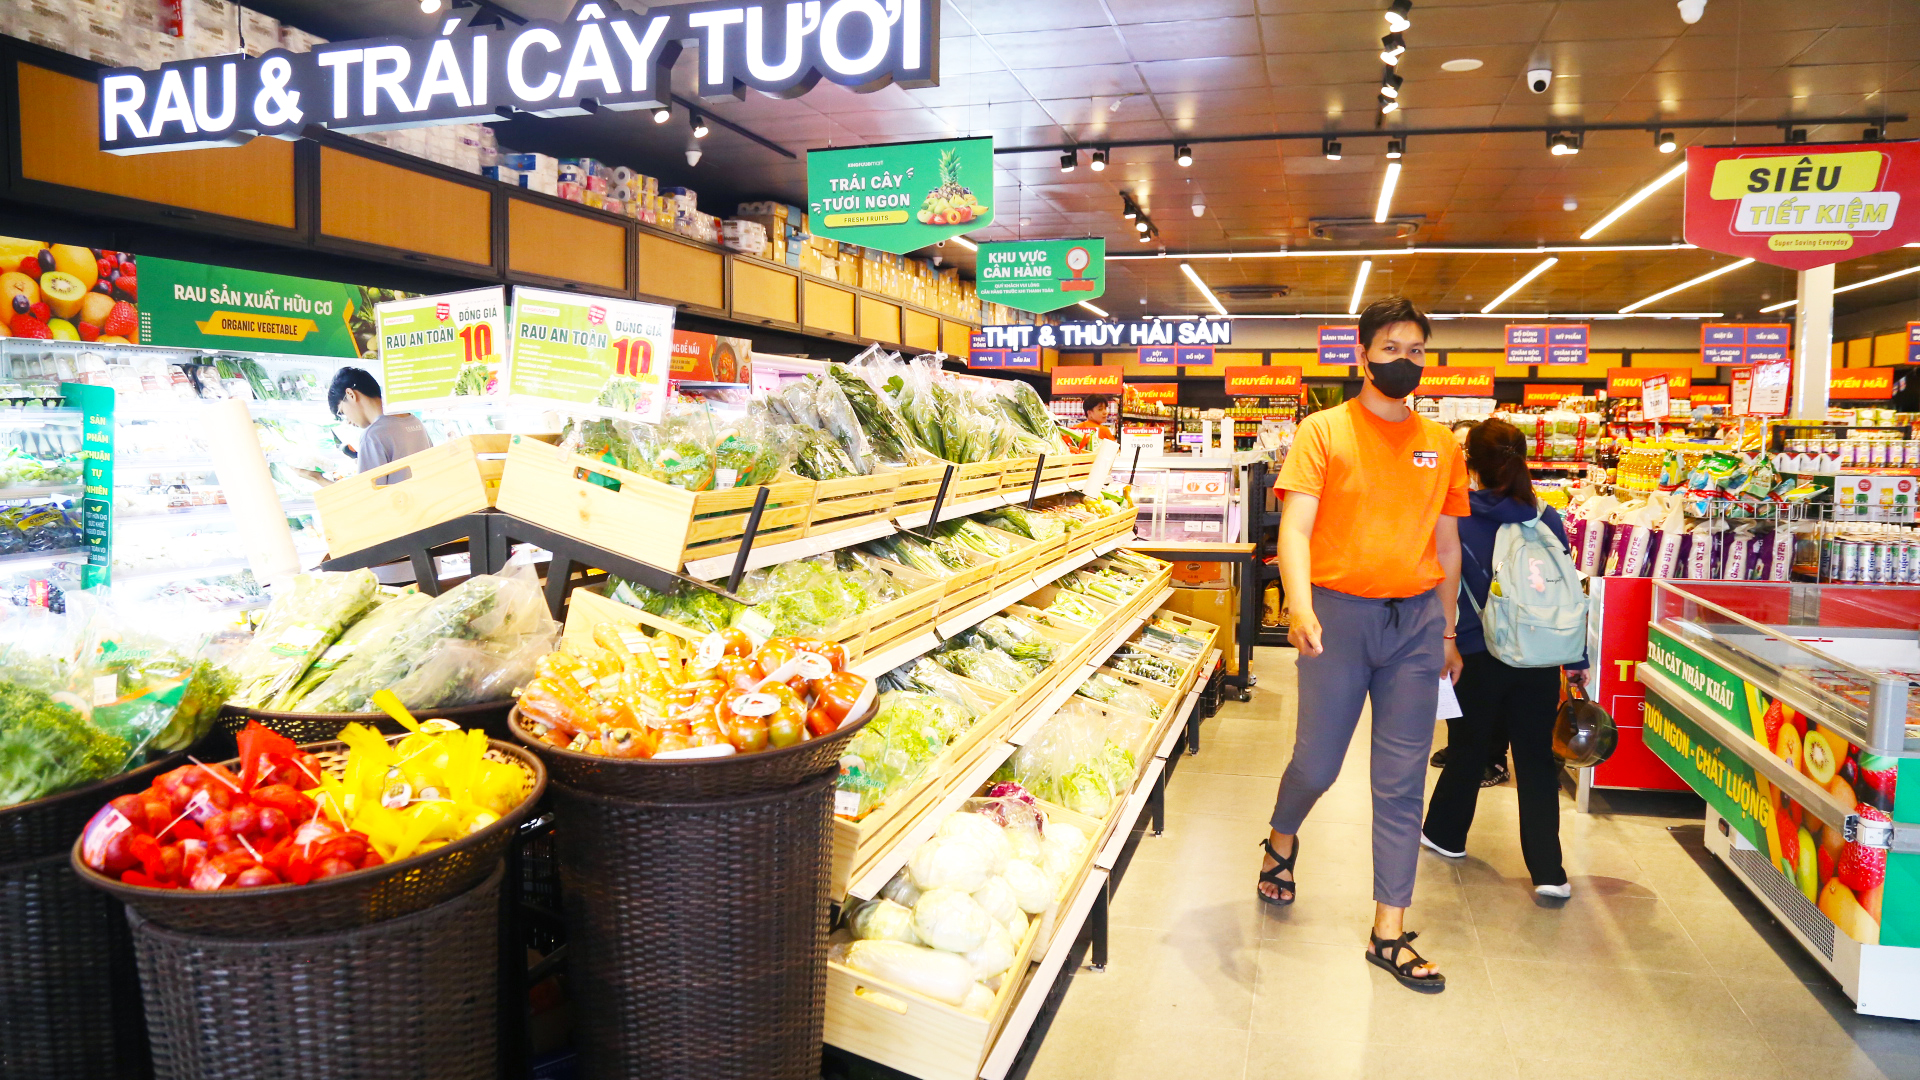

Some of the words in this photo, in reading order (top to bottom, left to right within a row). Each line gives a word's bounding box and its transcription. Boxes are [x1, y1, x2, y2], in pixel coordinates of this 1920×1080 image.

[103, 63, 236, 141] RAU
[254, 56, 304, 127] &
[318, 18, 488, 119] TRÁI
[507, 3, 670, 102] CÂY
[688, 0, 921, 86] TƯƠI
[829, 173, 866, 191] TRÁI
[870, 171, 903, 189] CÂY
[1747, 157, 1842, 193] SIÊU
[823, 195, 860, 212] TƯƠI
[865, 193, 911, 209] NGON
[1749, 196, 1810, 225] TIẾT
[1815, 197, 1889, 228] KIỆM
[1774, 239, 1793, 248] Super
[1795, 239, 1817, 248] Saving
[1818, 238, 1848, 247] Everyday
[988, 252, 1016, 263] KHU
[1019, 249, 1047, 265] VỰC
[983, 263, 1011, 278] CÂN
[1014, 262, 1052, 278] HÀNG
[174, 284, 207, 303] RAU
[210, 284, 241, 306] SẢN
[244, 288, 280, 310] XUẤT
[283, 294, 311, 313] HỮU
[314, 300, 333, 316] CƠ
[458, 307, 481, 321] ĐỒNG
[483, 304, 498, 318] GIÁ
[221, 318, 255, 332] ORGANIC
[257, 322, 298, 336] VEGETABLE
[520, 323, 547, 340] RAU
[550, 328, 569, 343] AN
[573, 329, 607, 348] TOÀN
[645, 322, 662, 337] GIÁ
[983, 326, 1034, 352] THỊT
[1038, 326, 1056, 347] &
[1060, 319, 1125, 346] THỦY
[1130, 319, 1173, 345] HẢI
[1178, 318, 1230, 345] SẢN
[386, 334, 406, 349] RAU
[409, 332, 423, 346] AN
[426, 325, 455, 343] TOÀN
[459, 324, 492, 362] 10
[688, 342, 700, 355] NẤU
[613, 338, 652, 377] 10
[1056, 375, 1097, 385] KHUYẾN
[1098, 375, 1118, 385] MÃI
[1231, 375, 1274, 385] KHUYẾN
[1275, 375, 1296, 385] MÃI
[1420, 374, 1465, 386] KHUYẾN
[1467, 374, 1490, 385] MÃI
[1863, 377, 1888, 388] MÃI
[1528, 392, 1561, 400] KHUYẾN
[1711, 394, 1726, 402] MÃI
[89, 413, 106, 426] SẢN
[86, 430, 109, 444] PHẨM
[91, 468, 103, 480] TỰ
[86, 484, 109, 496] NHIÊN
[1588, 530, 1598, 549] ST25
[1630, 536, 1642, 556] ST25
[1648, 641, 1665, 666] TRÁI
[1665, 651, 1681, 676] CÂY
[1682, 661, 1706, 692] NHẬP
[1706, 680, 1735, 711] KHẨU
[1644, 701, 1662, 737] TƯƠI
[1663, 718, 1690, 760] NGON
[1695, 745, 1726, 789] CHẤT
[1726, 768, 1769, 828] LƯỢNG
